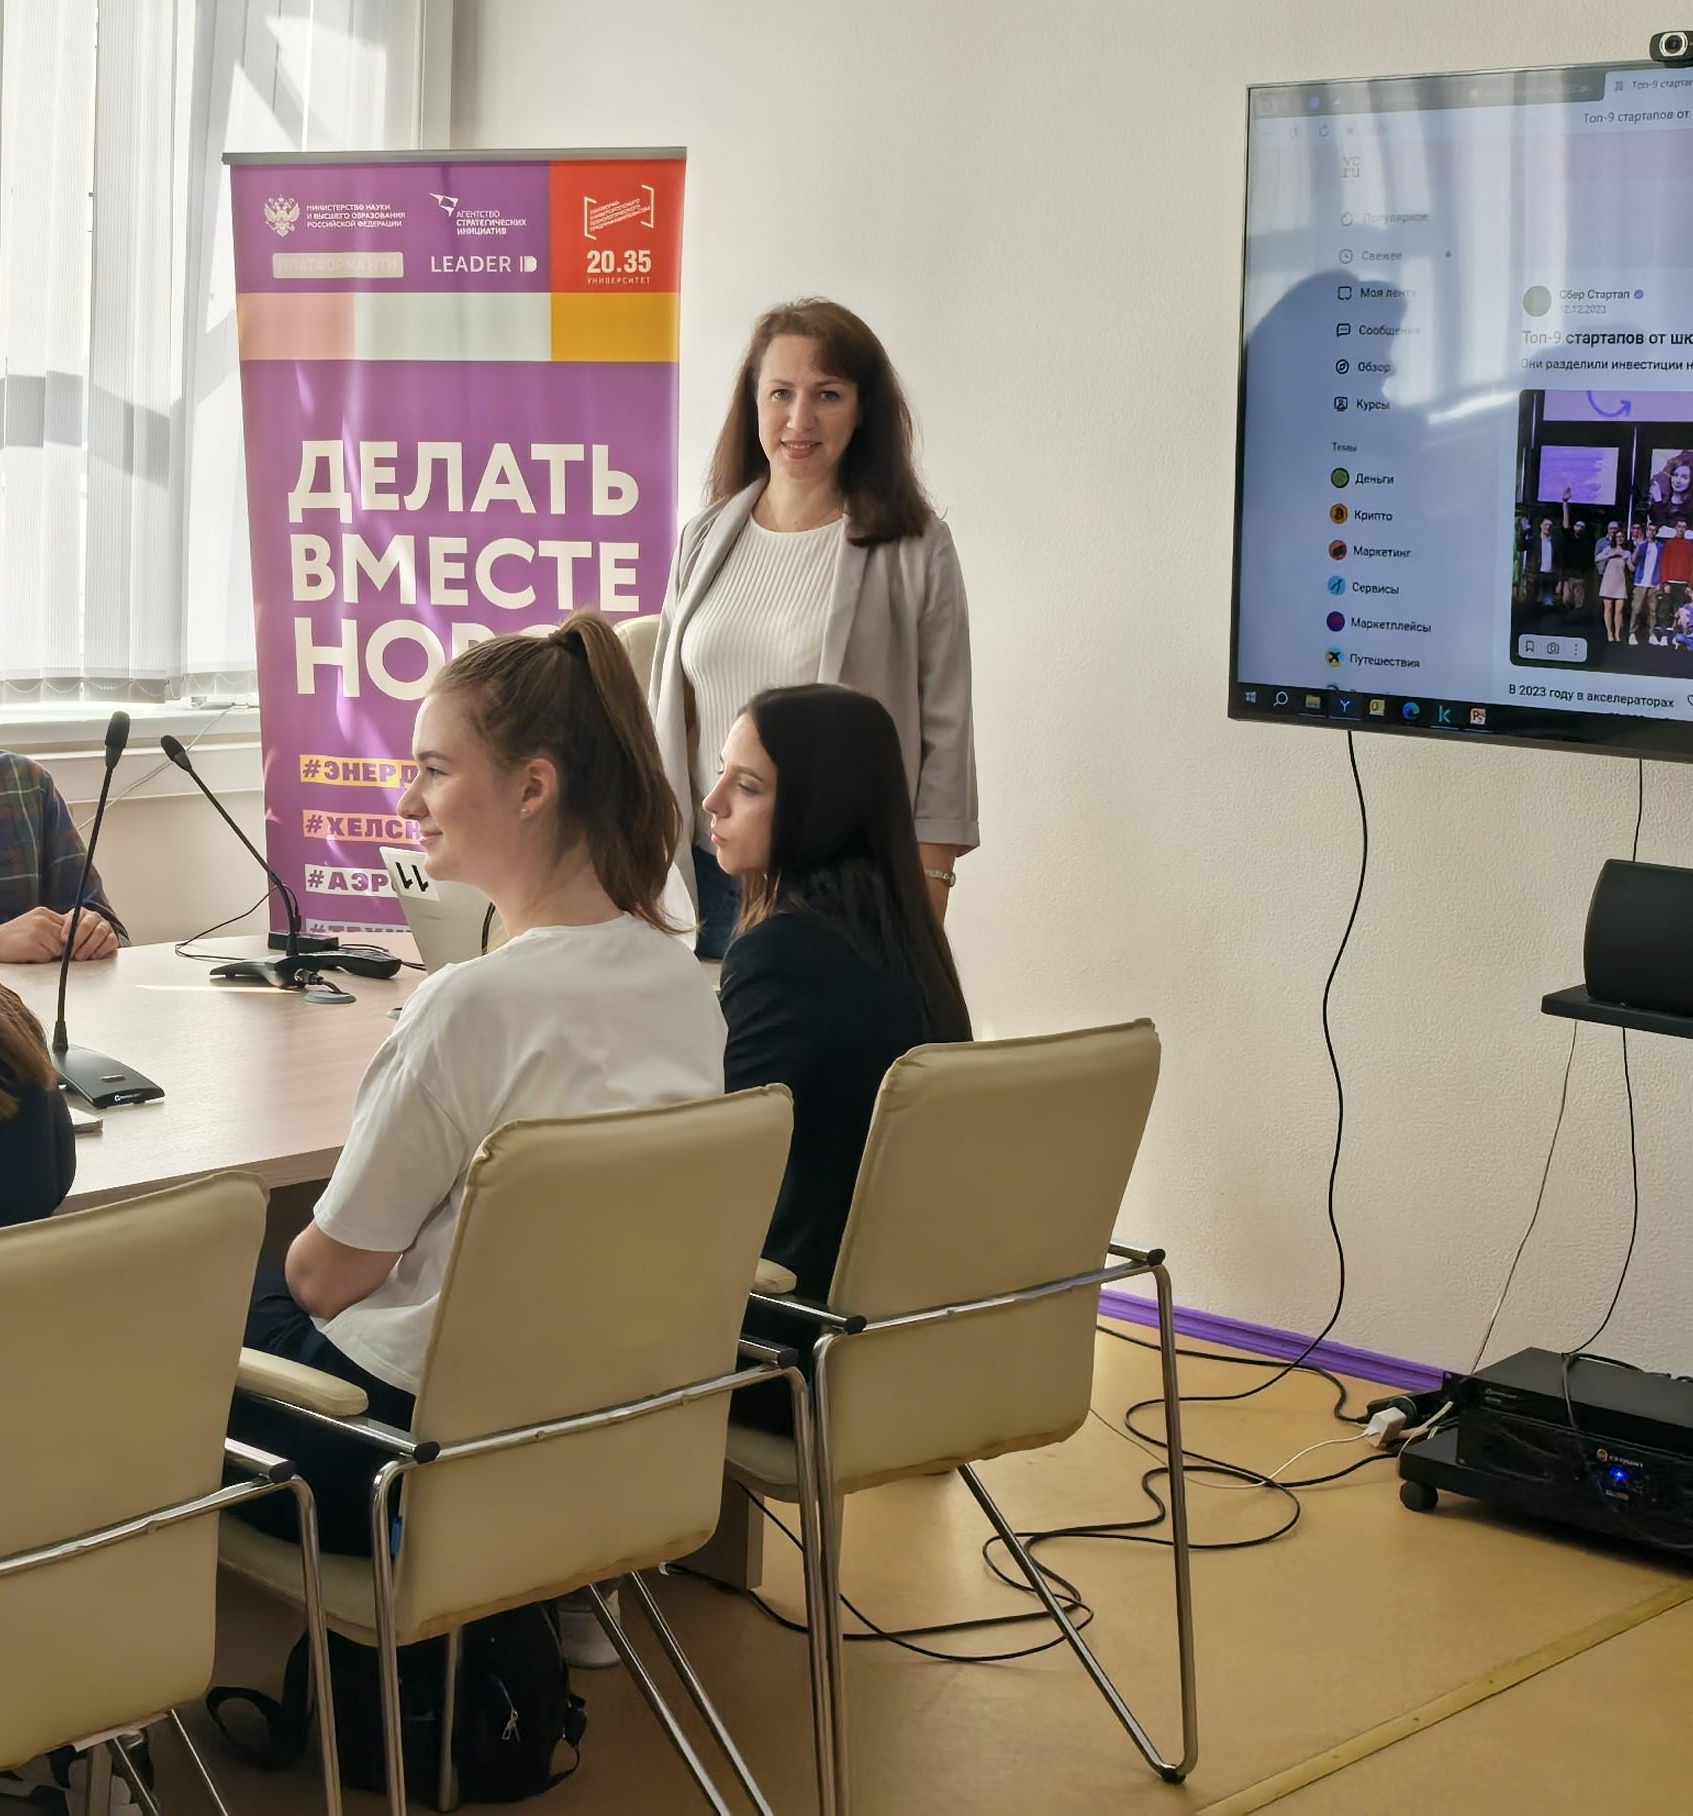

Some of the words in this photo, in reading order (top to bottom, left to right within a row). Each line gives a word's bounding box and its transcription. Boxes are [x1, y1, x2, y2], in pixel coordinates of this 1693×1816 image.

[1583, 112, 1615, 124] Топ-9
[1617, 110, 1674, 124] стартапов
[1676, 110, 1690, 119] от
[306, 204, 365, 212] МИНИСТЕРСТВО
[365, 203, 391, 211] НАУКИ
[456, 210, 500, 218] АГЕНТСТВО
[351, 212, 405, 220] ОБРАЗОВАНИЯ
[456, 218, 527, 227] СТРАТЕГИЧЕСКИХ
[307, 220, 357, 228] РОССИЙСКОЙ
[357, 220, 403, 228] ФЕДЕРАЦИИ
[456, 227, 507, 236] ИНИЦИАТИВ
[430, 255, 512, 273] LEADER
[586, 249, 652, 274] 20.35
[587, 276, 651, 285] УНИВЕРСИТЕТ
[1359, 287, 1383, 298] Моя
[1559, 289, 1585, 301] Сбер
[1587, 289, 1630, 301] Стартап
[1522, 330, 1562, 345] Топ-9
[1565, 333, 1645, 348] стартапов
[1648, 334, 1666, 345] от
[1357, 361, 1391, 375] Обзор
[1520, 357, 1543, 370] Они
[1545, 359, 1609, 373] разделили
[1611, 361, 1683, 372] инвестиции
[1356, 398, 1390, 412] Курсы
[1332, 441, 1357, 453] Темы
[287, 440, 640, 525] ДЕЛАТЬ
[1354, 473, 1395, 485] Деньги
[1354, 509, 1393, 523] Крипто
[1353, 545, 1412, 559] Маркетинг
[289, 533, 640, 613] ВМЕСТЕ
[1351, 582, 1400, 595] Сервисы
[1350, 616, 1432, 633] Маркетплейсы
[1349, 653, 1421, 668] Путешествия
[1508, 684, 1516, 694] В
[1519, 685, 1546, 697] 2023
[1548, 688, 1575, 702] году
[1576, 692, 1584, 700] в
[1586, 692, 1675, 709] акселераторах
[307, 869, 395, 893] #АЭР
